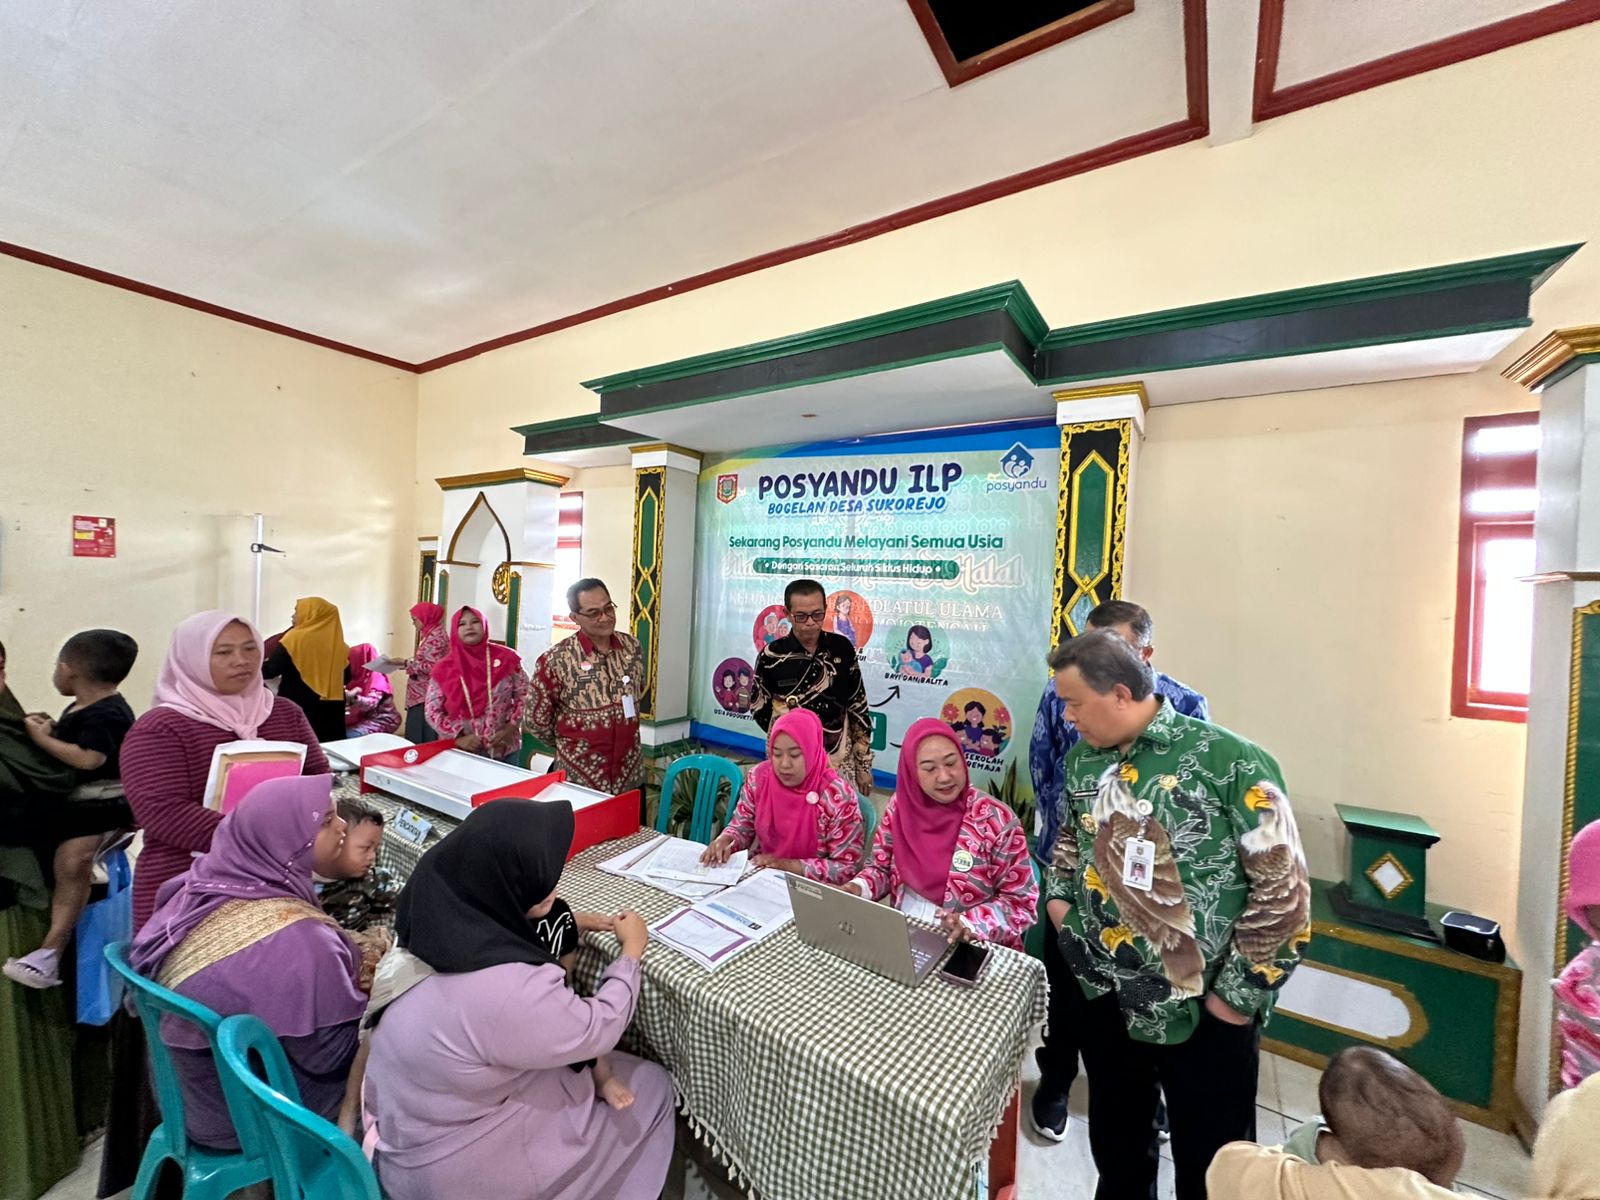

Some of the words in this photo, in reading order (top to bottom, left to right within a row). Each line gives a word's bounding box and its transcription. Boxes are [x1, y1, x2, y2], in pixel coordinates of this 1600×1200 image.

[758, 467, 898, 500] POSYANDU
[908, 462, 963, 493] ILP
[987, 477, 1047, 493] posyandu
[768, 502, 826, 515] BOGELAN
[829, 500, 863, 513] DESA
[866, 497, 946, 512] SUKOREJO
[729, 536, 781, 550] Sekarang
[782, 536, 842, 550] Posyandu
[844, 535, 908, 550] Melayani
[911, 535, 965, 548] Semua
[968, 535, 1003, 548] Usia
[771, 561, 803, 572] Dengan
[902, 564, 933, 575] Hidup
[939, 603, 1004, 619] ULAMA
[965, 752, 1004, 765] SEKOLAH
